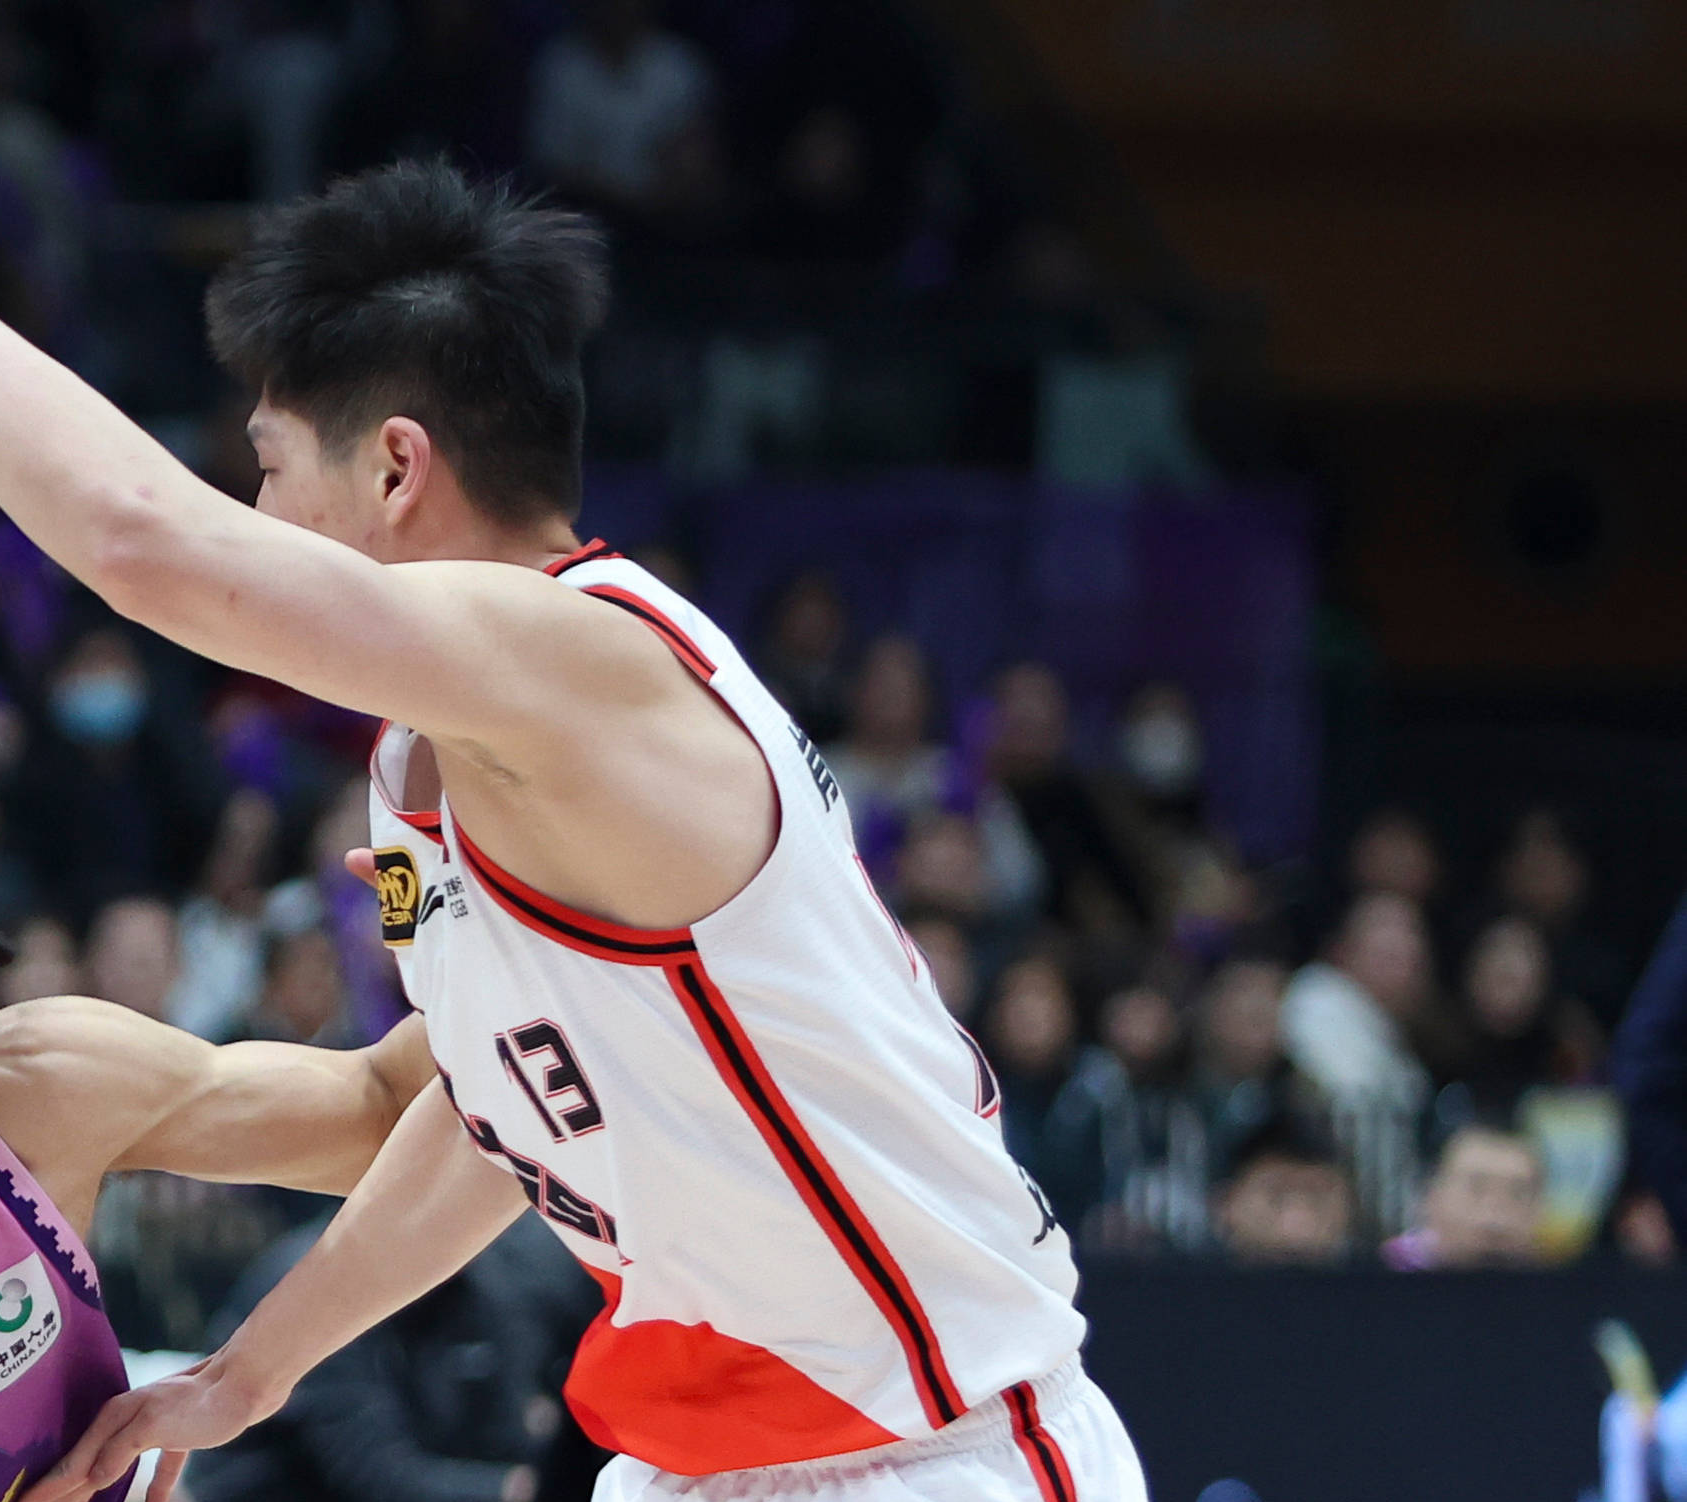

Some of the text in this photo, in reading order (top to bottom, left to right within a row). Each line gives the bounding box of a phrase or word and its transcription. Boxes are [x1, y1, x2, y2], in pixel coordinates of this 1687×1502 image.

[494, 1017, 605, 1144] 13
[0, 1322, 57, 1379] CHINA LIFE
